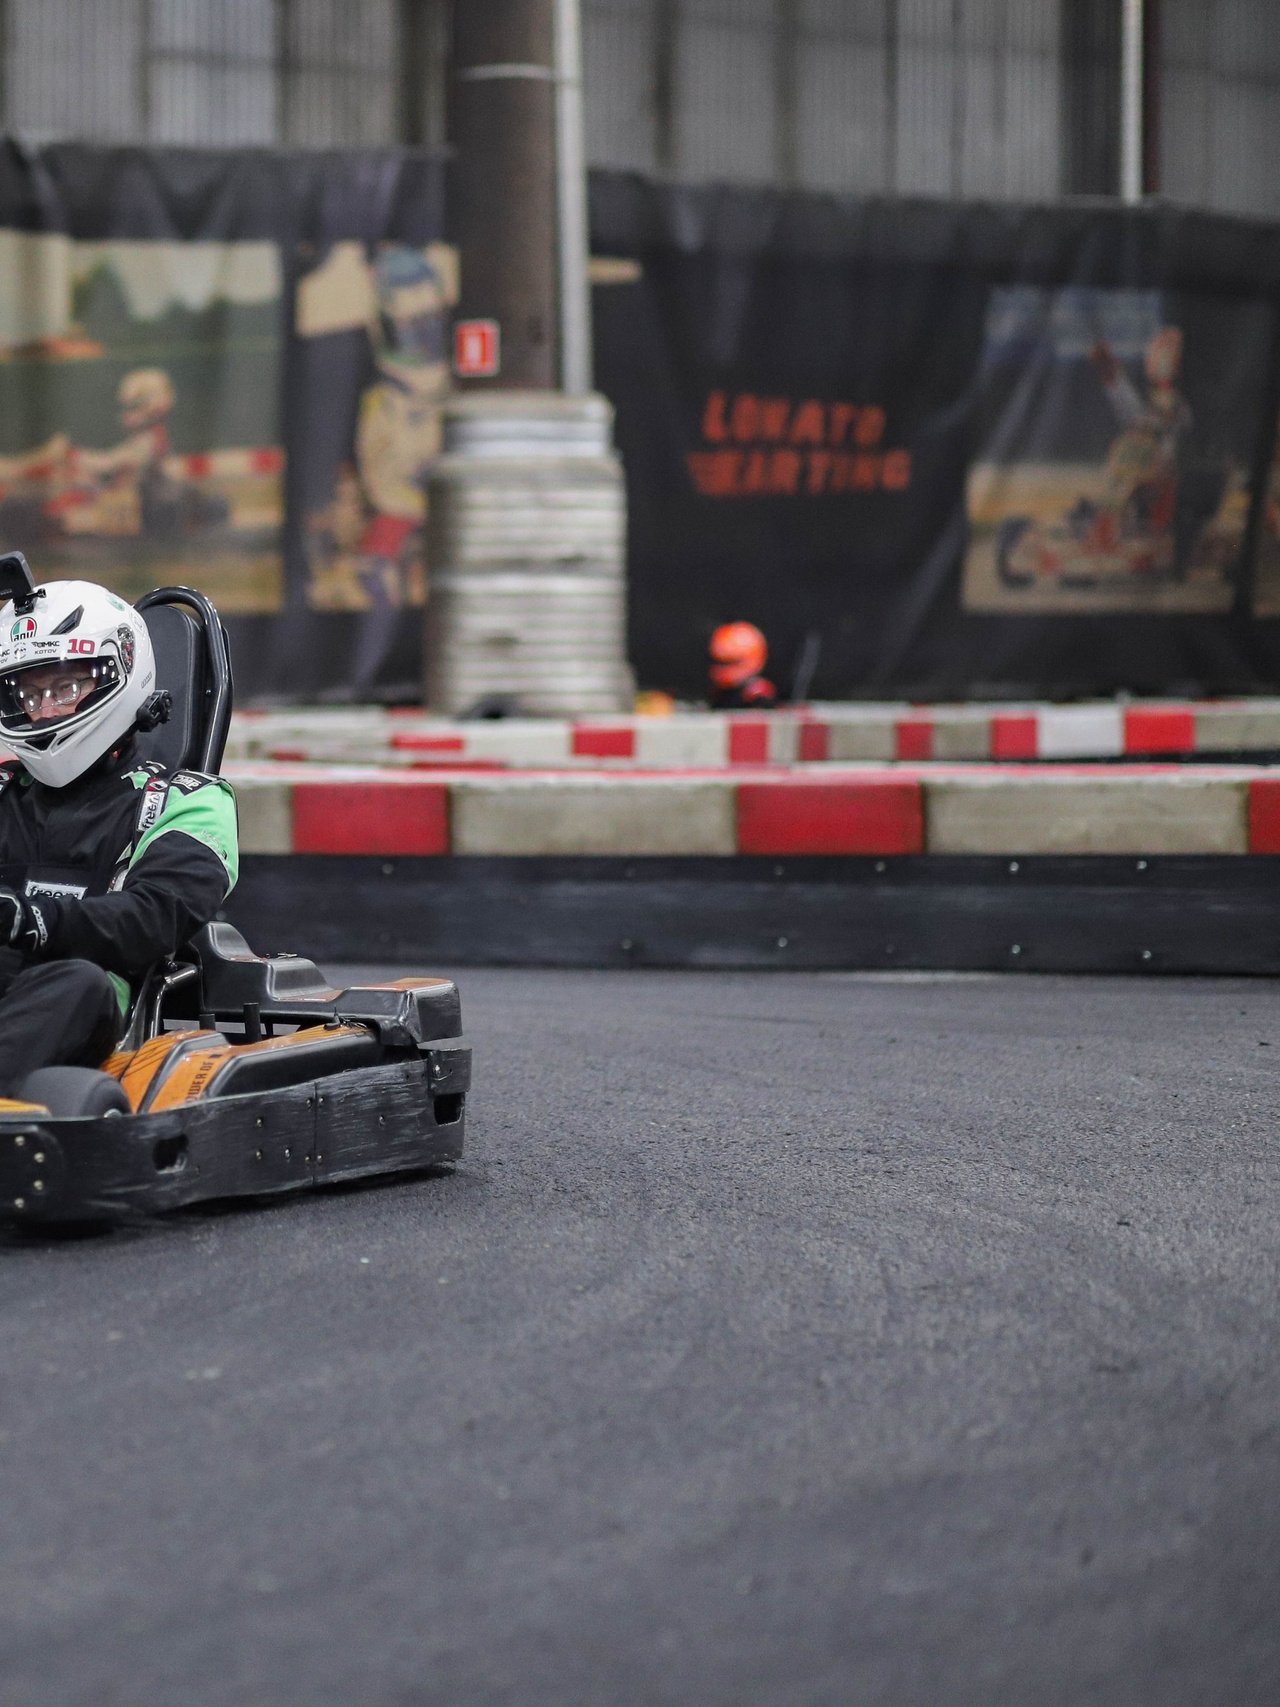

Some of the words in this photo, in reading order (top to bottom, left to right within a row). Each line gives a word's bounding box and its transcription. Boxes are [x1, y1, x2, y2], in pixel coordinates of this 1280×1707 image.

[703, 390, 886, 445] LONATO
[694, 450, 911, 495] KARTING
[68, 639, 95, 654] 10
[171, 776, 201, 789] OMP
